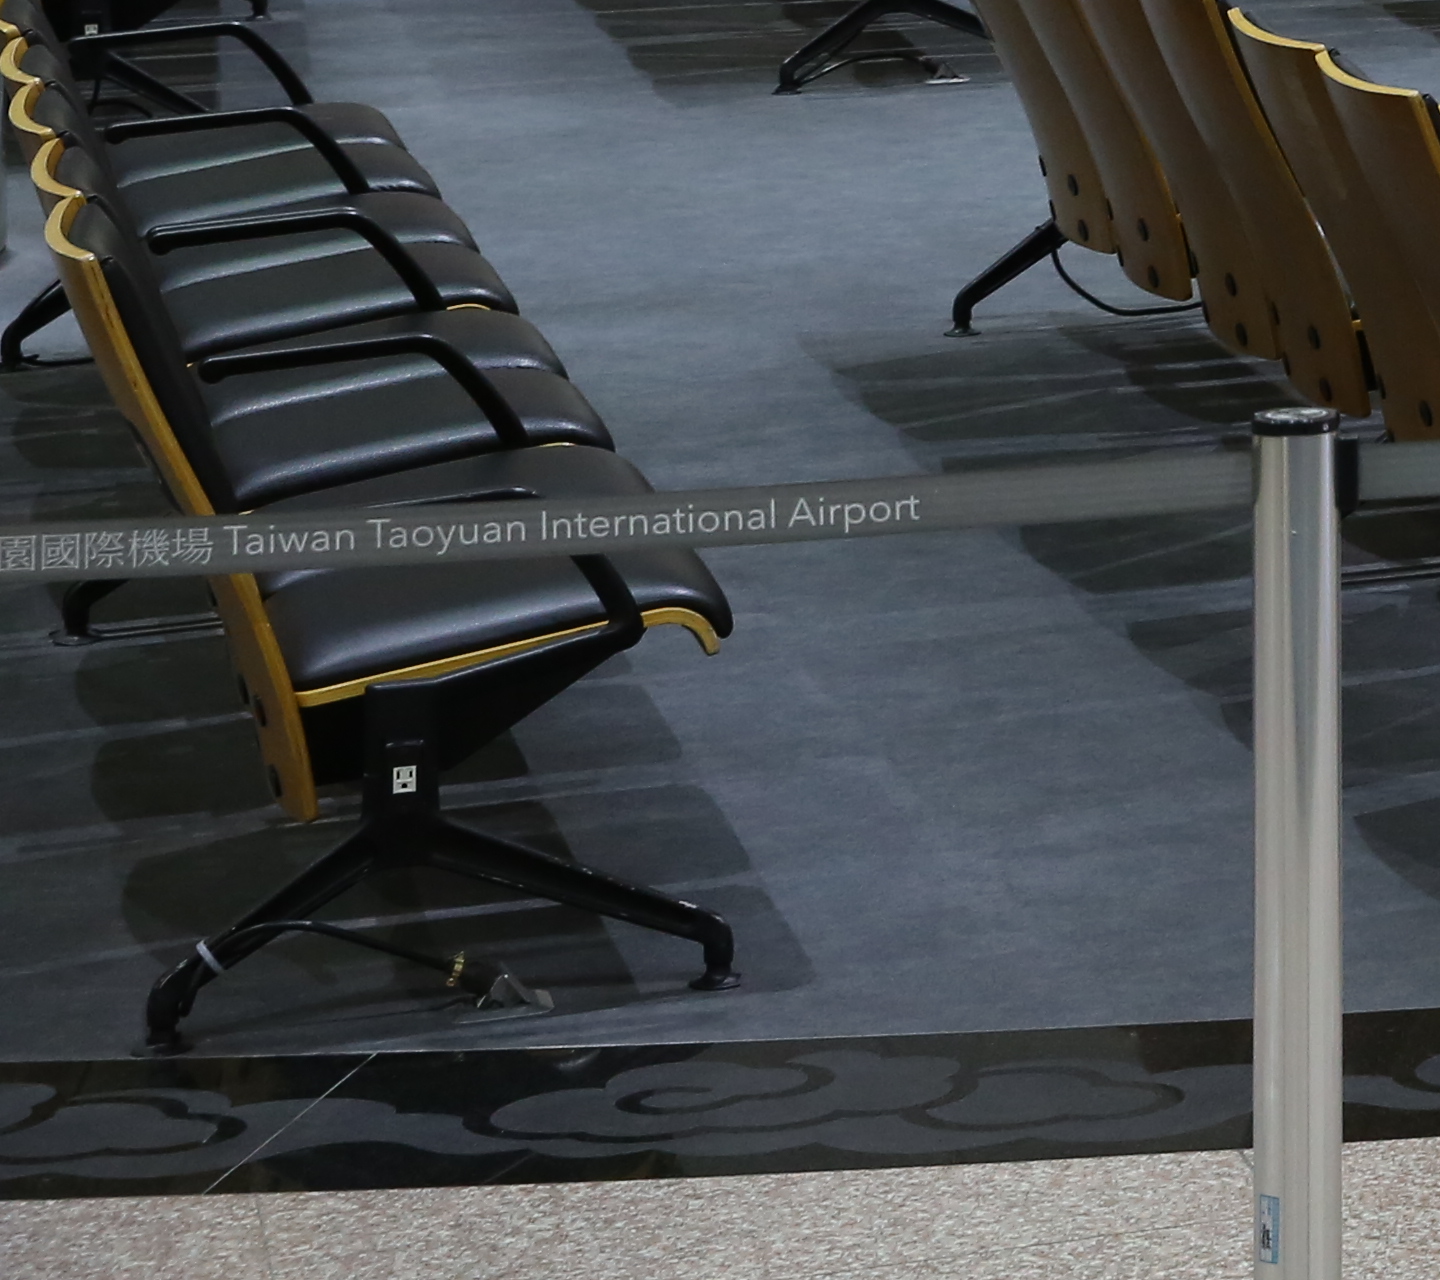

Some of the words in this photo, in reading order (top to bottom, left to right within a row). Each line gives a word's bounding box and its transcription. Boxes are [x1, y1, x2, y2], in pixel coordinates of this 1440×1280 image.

[227, 520, 356, 558] Taiwan
[367, 512, 525, 558] Taoyuan
[540, 498, 777, 540] International
[787, 490, 921, 534] Airport
